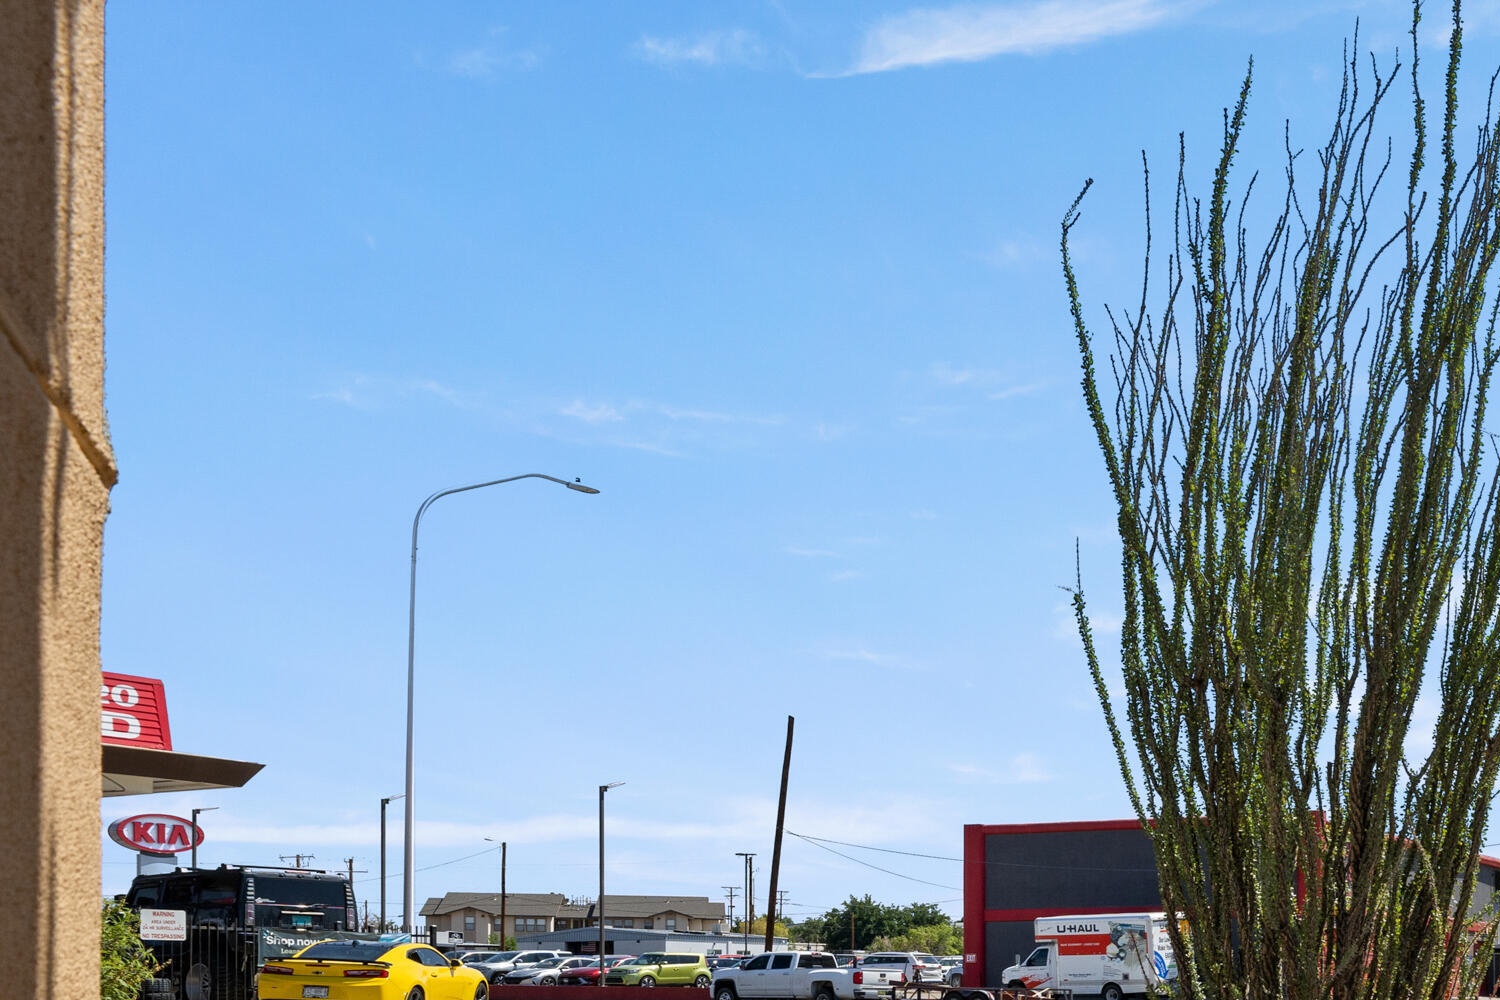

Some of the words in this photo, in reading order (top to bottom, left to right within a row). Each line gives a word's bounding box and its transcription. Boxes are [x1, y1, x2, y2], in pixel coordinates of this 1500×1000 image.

[132, 822, 190, 846] KIA
[1057, 924, 1099, 933] U-HAUL
[266, 935, 295, 947] Shop
[297, 938, 320, 947] now
